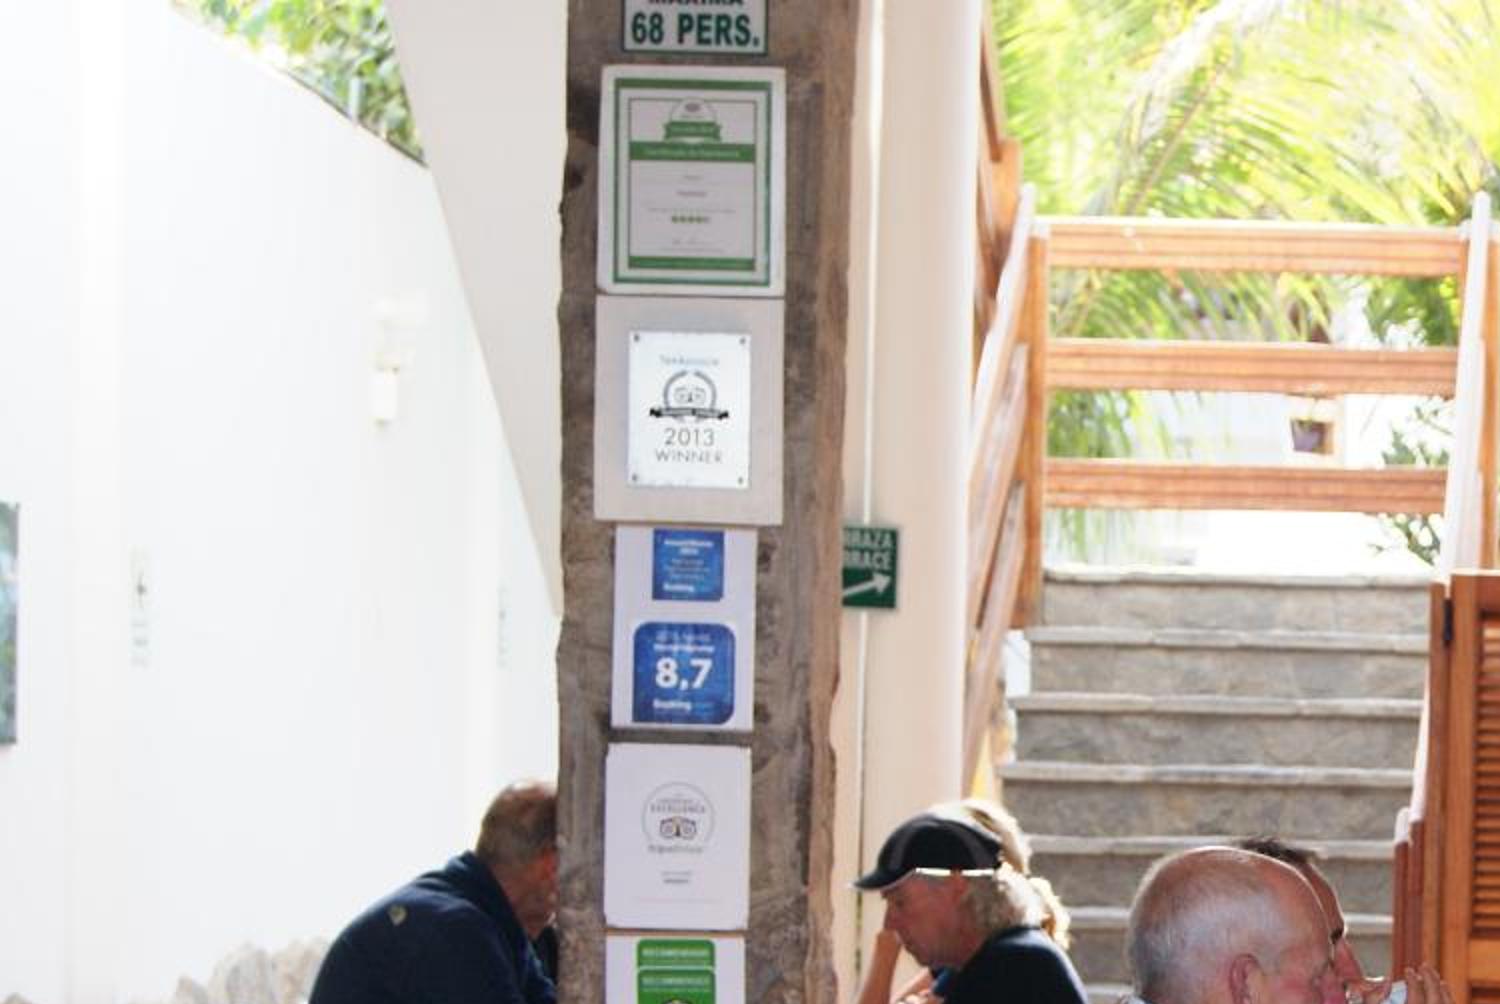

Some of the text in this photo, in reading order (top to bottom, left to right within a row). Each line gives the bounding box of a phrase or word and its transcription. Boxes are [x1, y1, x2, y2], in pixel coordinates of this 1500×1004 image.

[632, 11, 759, 46] 68 PERS.
[663, 426, 715, 447] 2013
[655, 449, 722, 464] WINNER
[655, 657, 713, 691] 8,7
